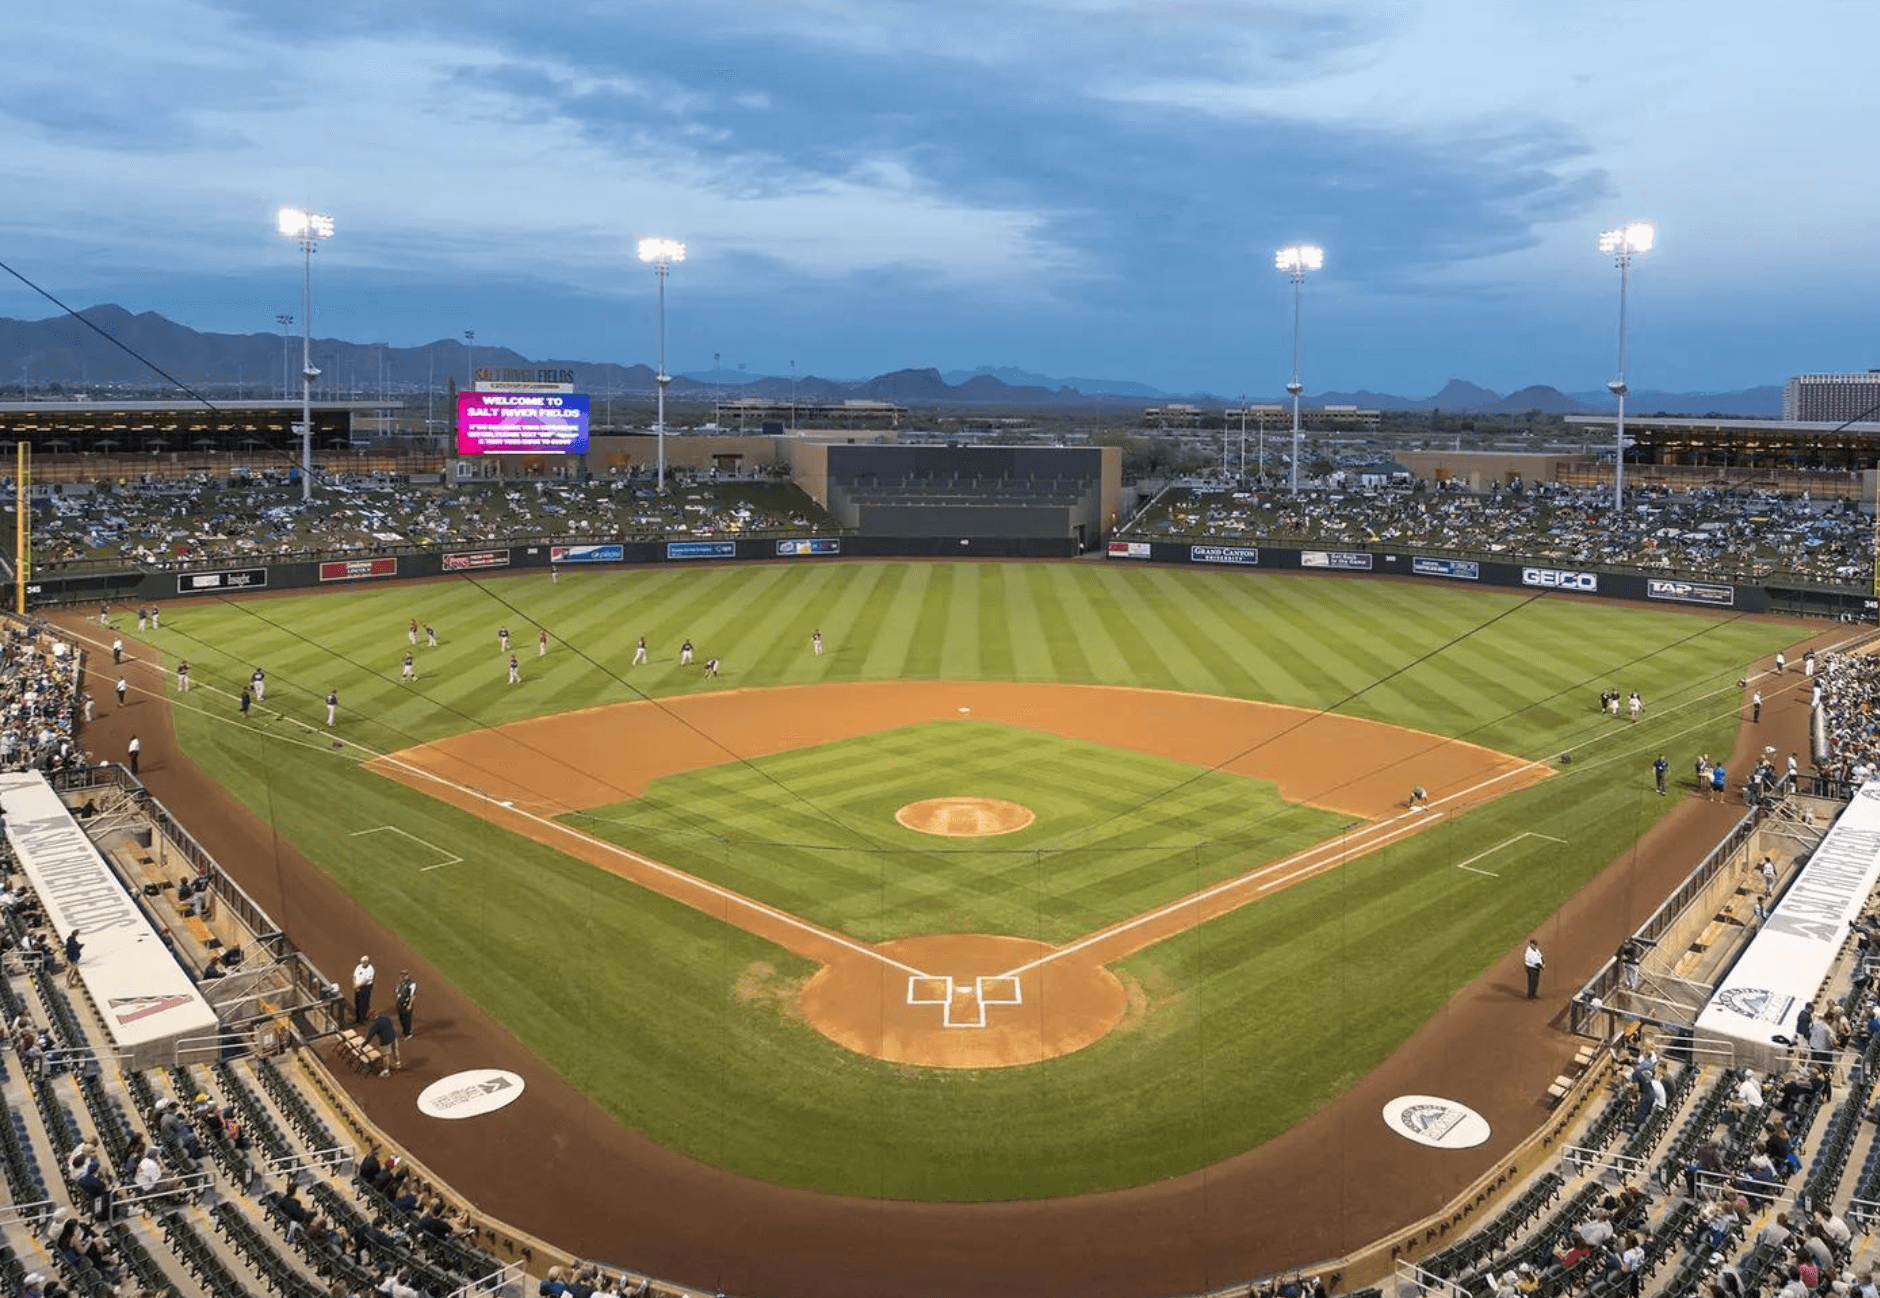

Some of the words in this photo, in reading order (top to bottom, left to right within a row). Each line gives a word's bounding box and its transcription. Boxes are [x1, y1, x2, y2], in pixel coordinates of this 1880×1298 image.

[538, 369, 574, 383] FIELDS
[482, 396, 544, 406] WELCOME
[546, 397, 563, 406] TO
[467, 407, 499, 417] SALT
[501, 408, 538, 418] RIVER
[539, 408, 580, 418] FIELDS
[1193, 547, 1222, 556] GRAND
[1223, 548, 1255, 558] CANYON
[1522, 567, 1597, 590] GEICO
[1864, 600, 1879, 609] 345
[21, 831, 88, 858] SALT
[35, 854, 108, 893] RIVER
[53, 886, 137, 935] FIELDS
